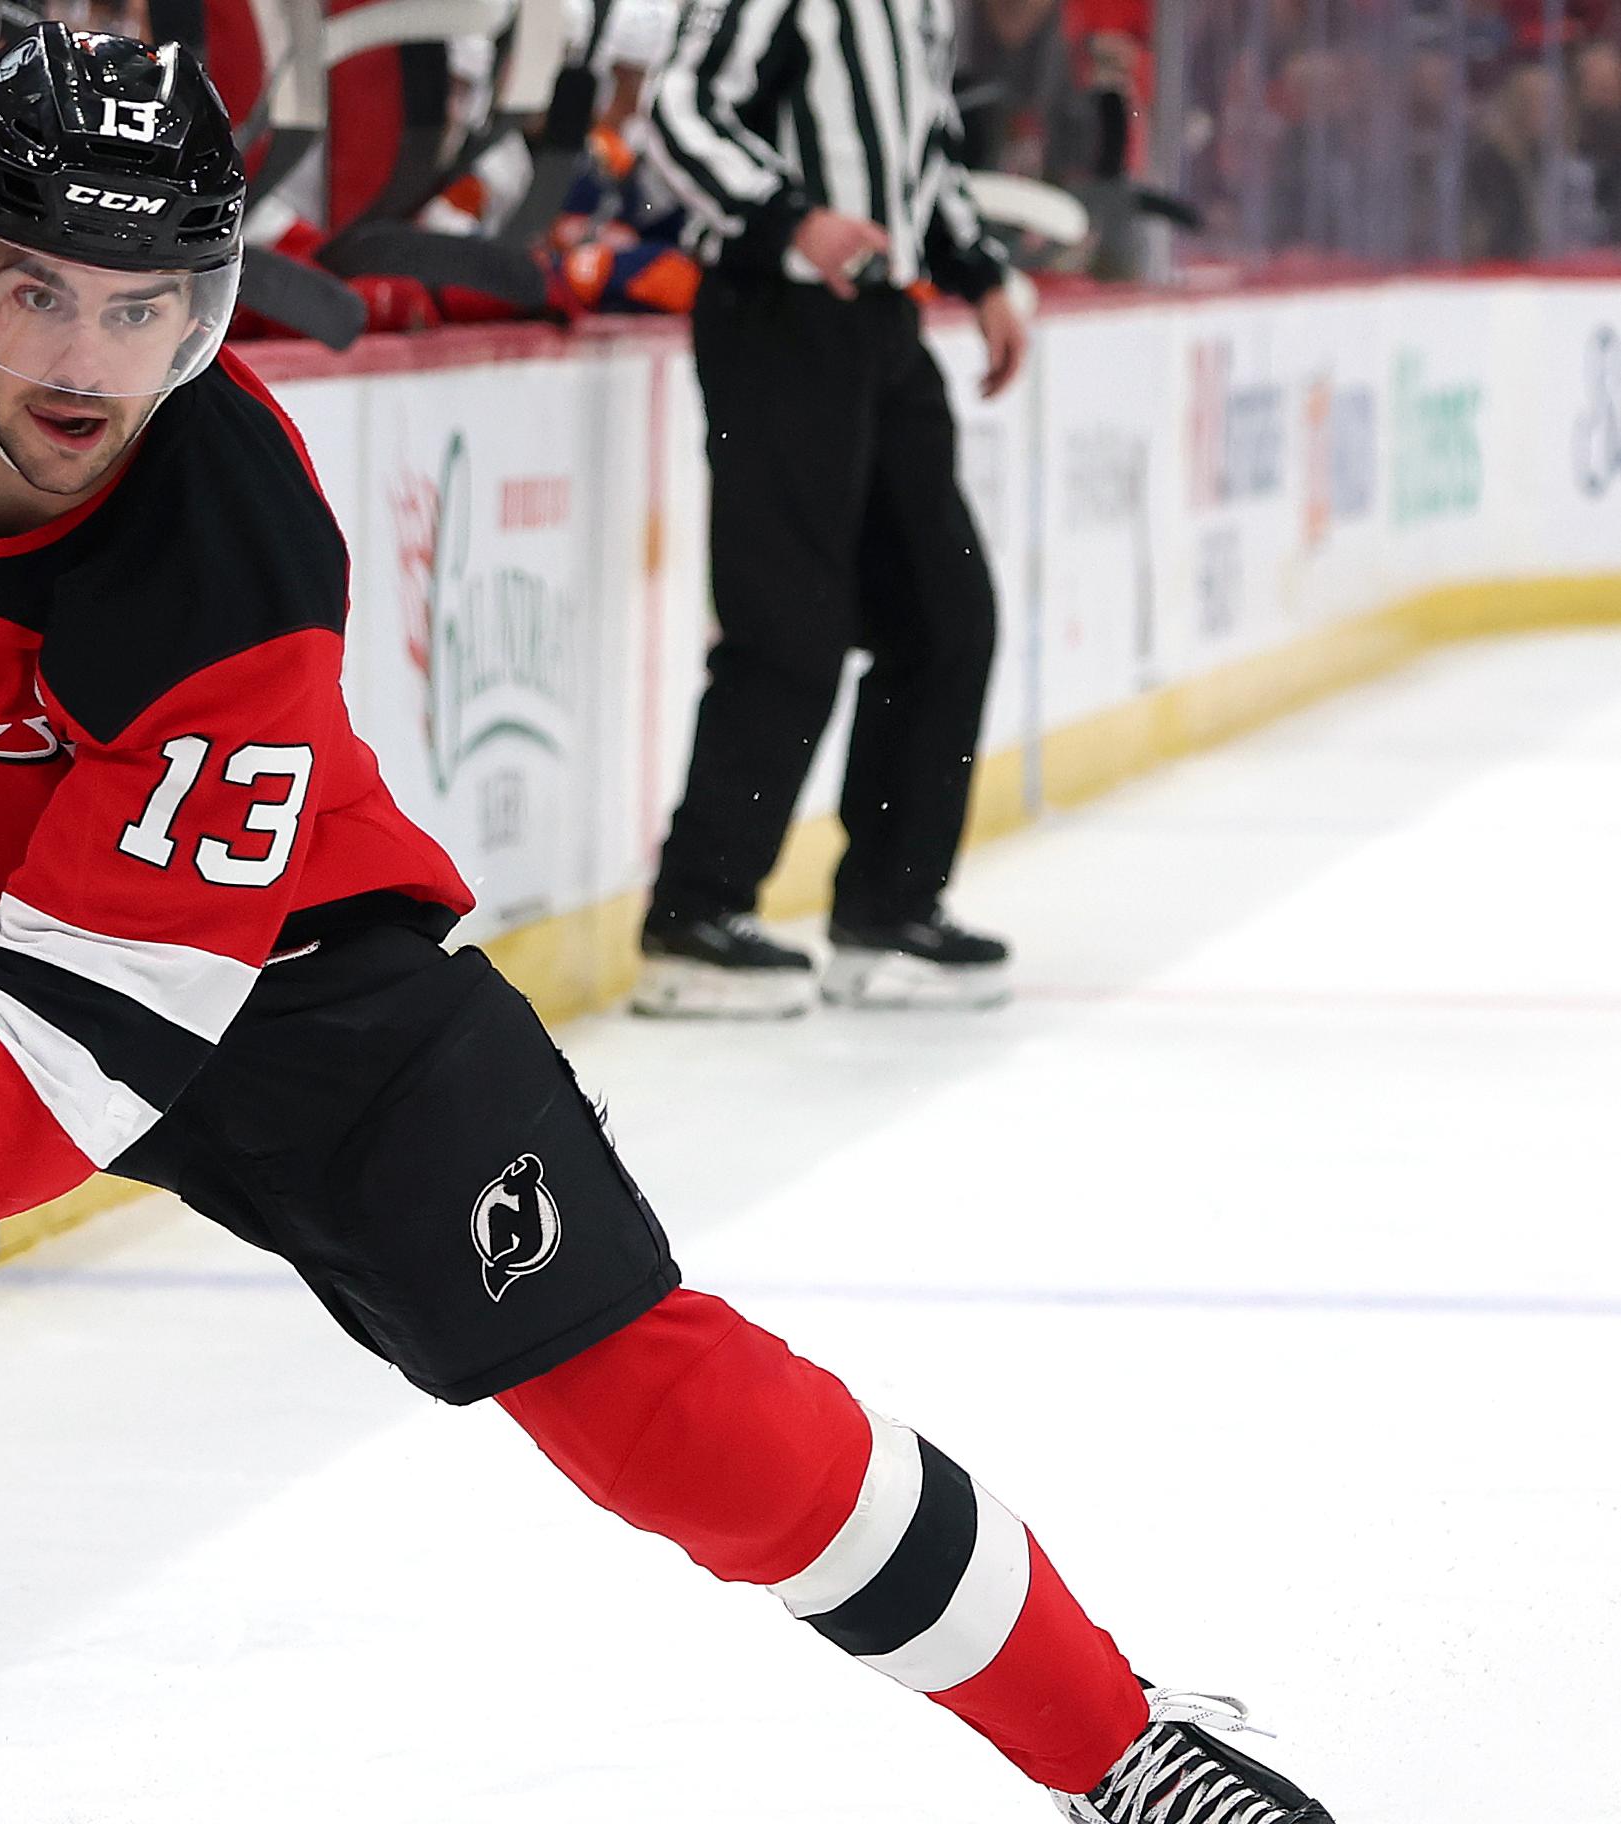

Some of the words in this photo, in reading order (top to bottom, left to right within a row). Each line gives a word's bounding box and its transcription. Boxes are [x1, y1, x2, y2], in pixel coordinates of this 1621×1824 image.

[100, 98, 165, 142] 13
[65, 183, 167, 214] CCM
[118, 734, 313, 888] 13
